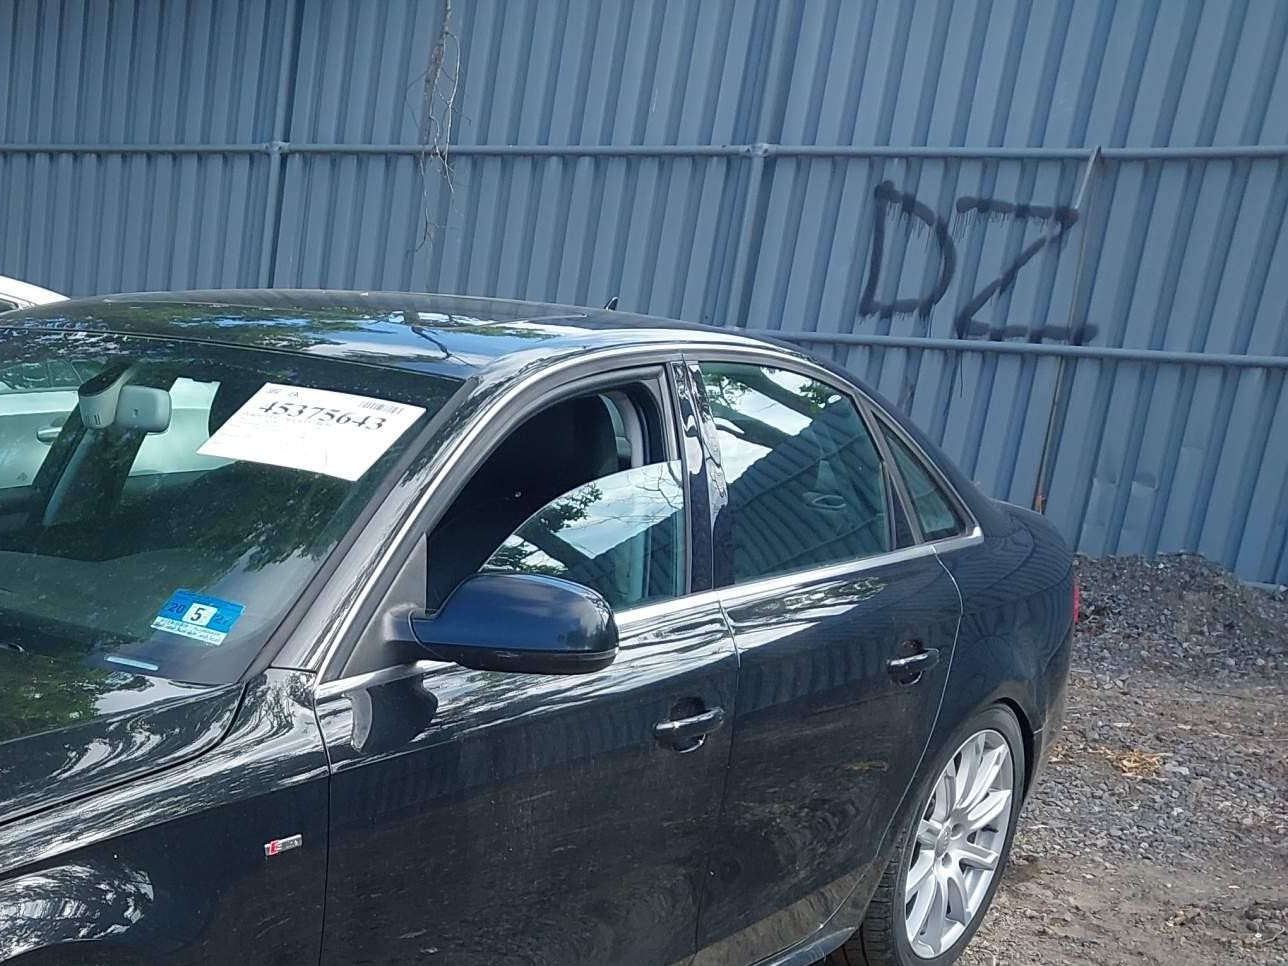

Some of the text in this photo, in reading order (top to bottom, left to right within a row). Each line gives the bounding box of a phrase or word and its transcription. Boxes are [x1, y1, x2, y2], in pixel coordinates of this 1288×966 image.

[858, 180, 1099, 346] DZ
[258, 400, 387, 431] 45375643
[190, 607, 206, 622] 5
